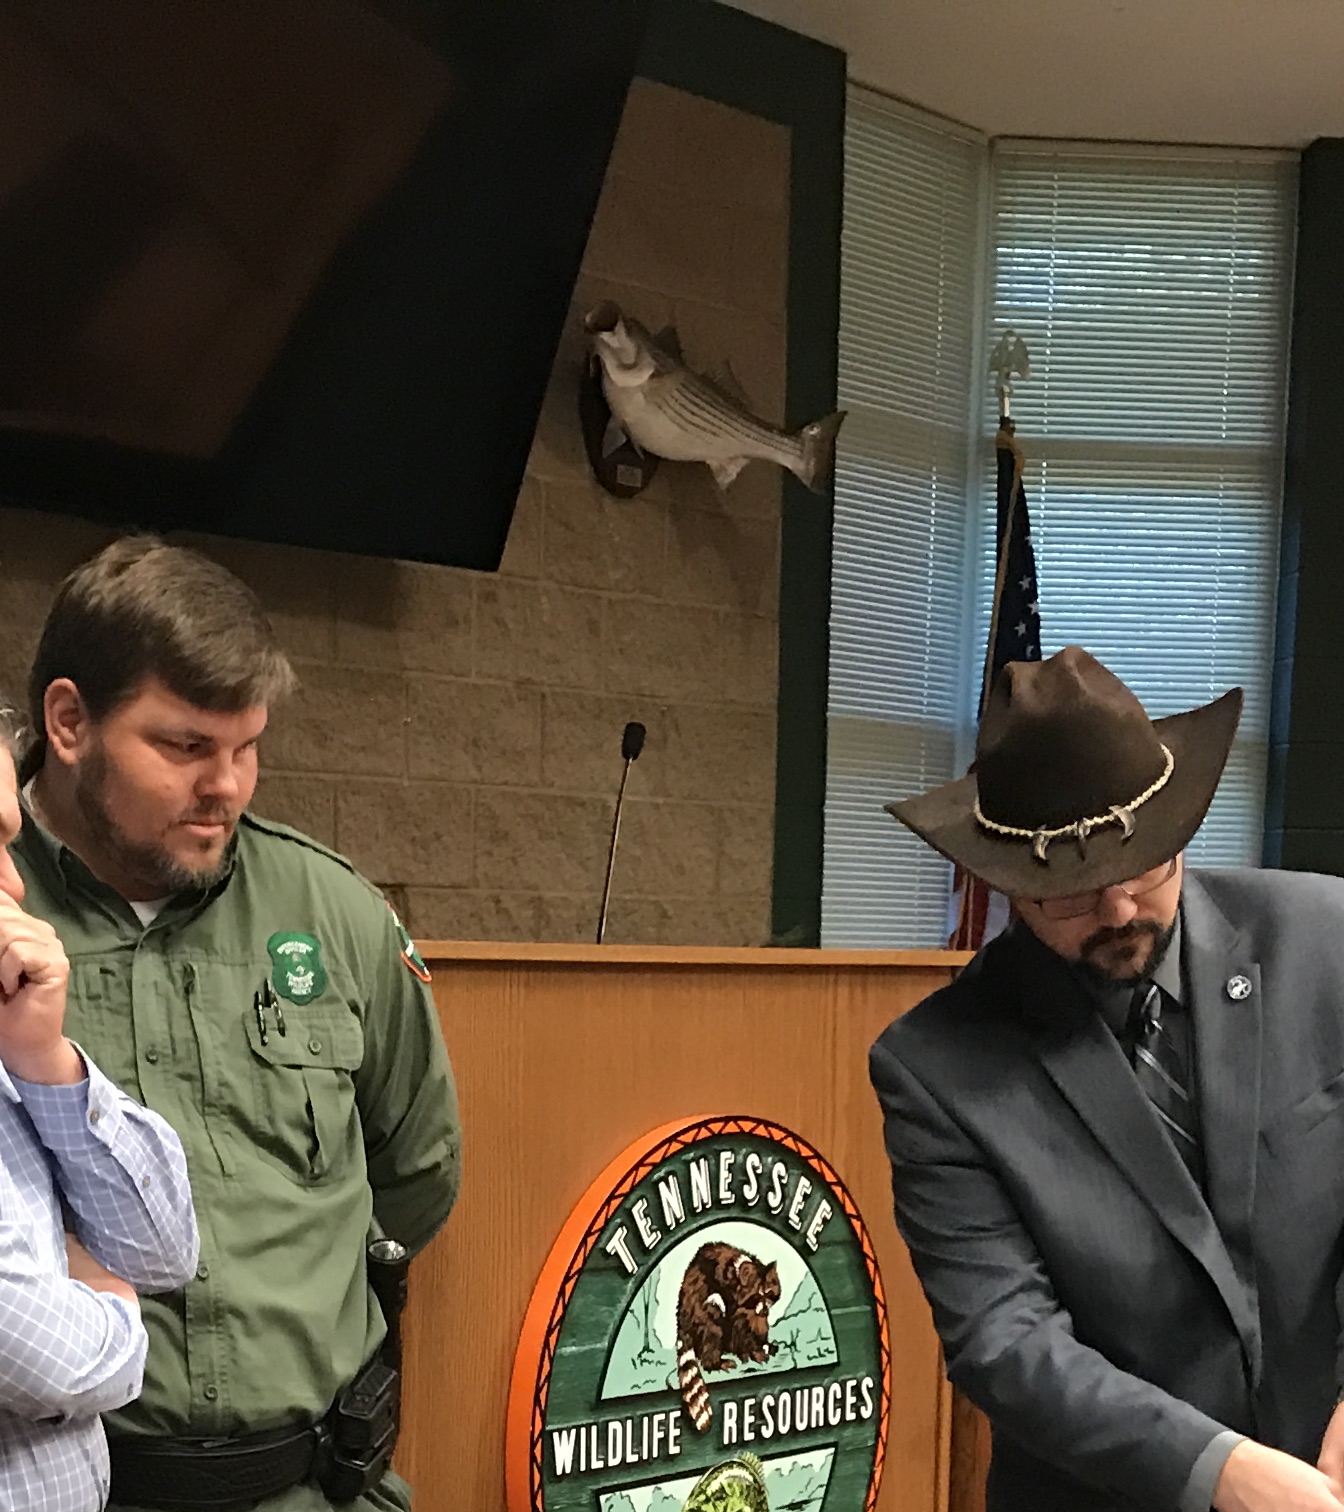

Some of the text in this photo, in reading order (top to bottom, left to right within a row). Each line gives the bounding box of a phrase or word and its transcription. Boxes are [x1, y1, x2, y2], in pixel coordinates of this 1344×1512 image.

[605, 1150, 833, 1277] TENNESSEE
[552, 1376, 875, 1476] WILDLIFE RESOURCES
